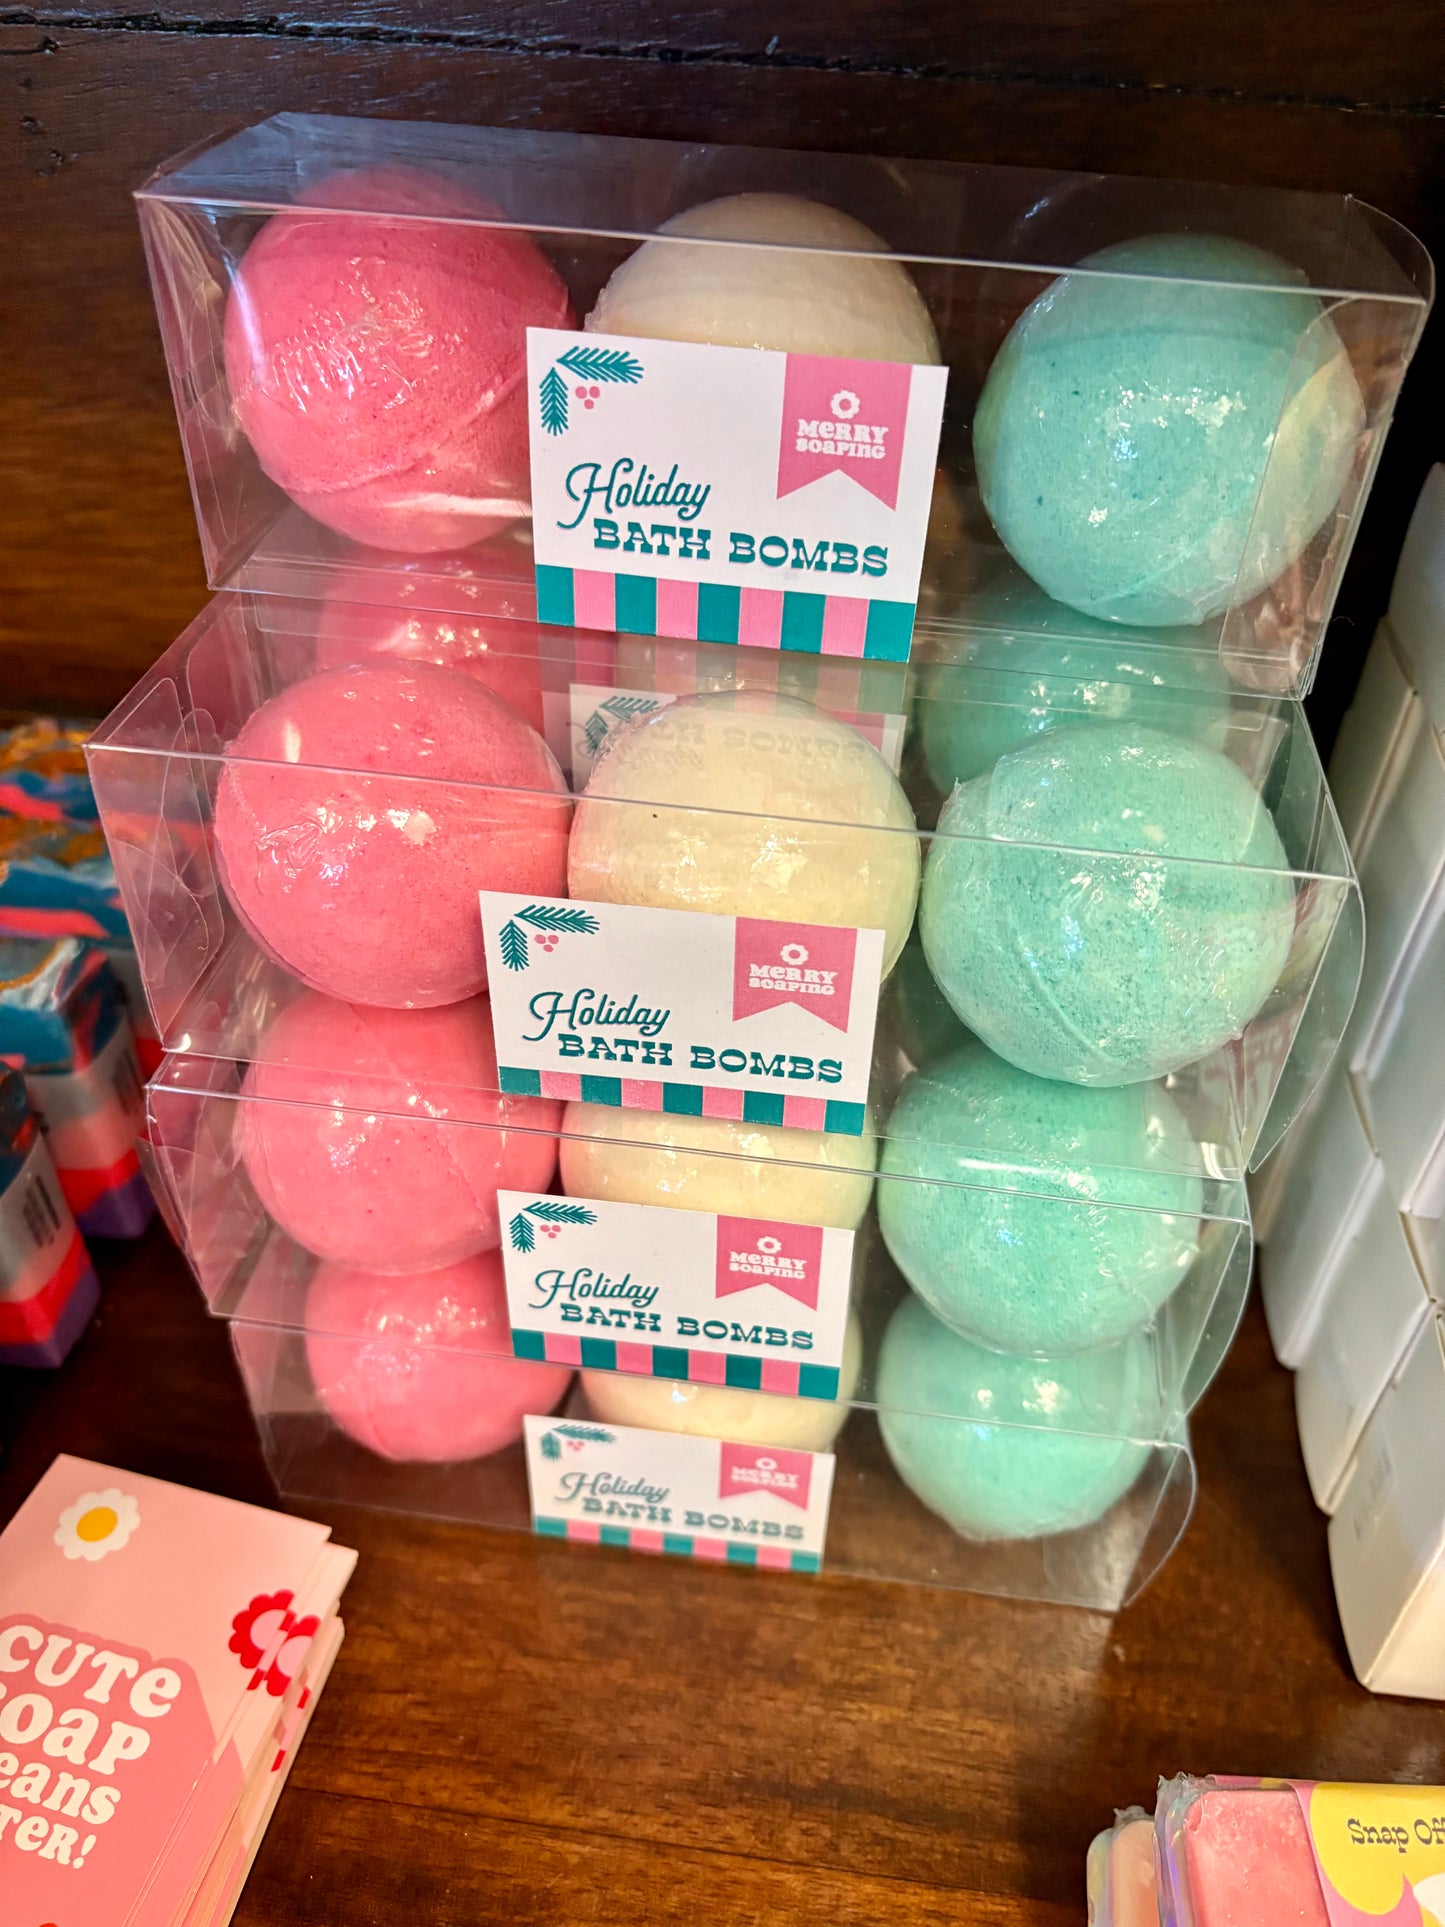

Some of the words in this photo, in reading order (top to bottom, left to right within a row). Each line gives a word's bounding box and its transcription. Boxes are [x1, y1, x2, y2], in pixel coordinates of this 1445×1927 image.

[556, 457, 712, 530] Holiday
[592, 518, 711, 561] BATH
[728, 532, 889, 578] BOMBS
[522, 988, 671, 1042] Holiday
[558, 1032, 673, 1066] BATH
[689, 1045, 843, 1084] BOMBS
[528, 1267, 660, 1309] Holiday
[560, 1302, 662, 1333] BATH
[677, 1316, 814, 1350] BOMBS
[554, 1471, 671, 1503] Holiday
[582, 1496, 672, 1523] BATH
[685, 1510, 804, 1540] BOMBS
[0, 1681, 151, 1776] OaP
[1347, 1818, 1409, 1854] Snap
